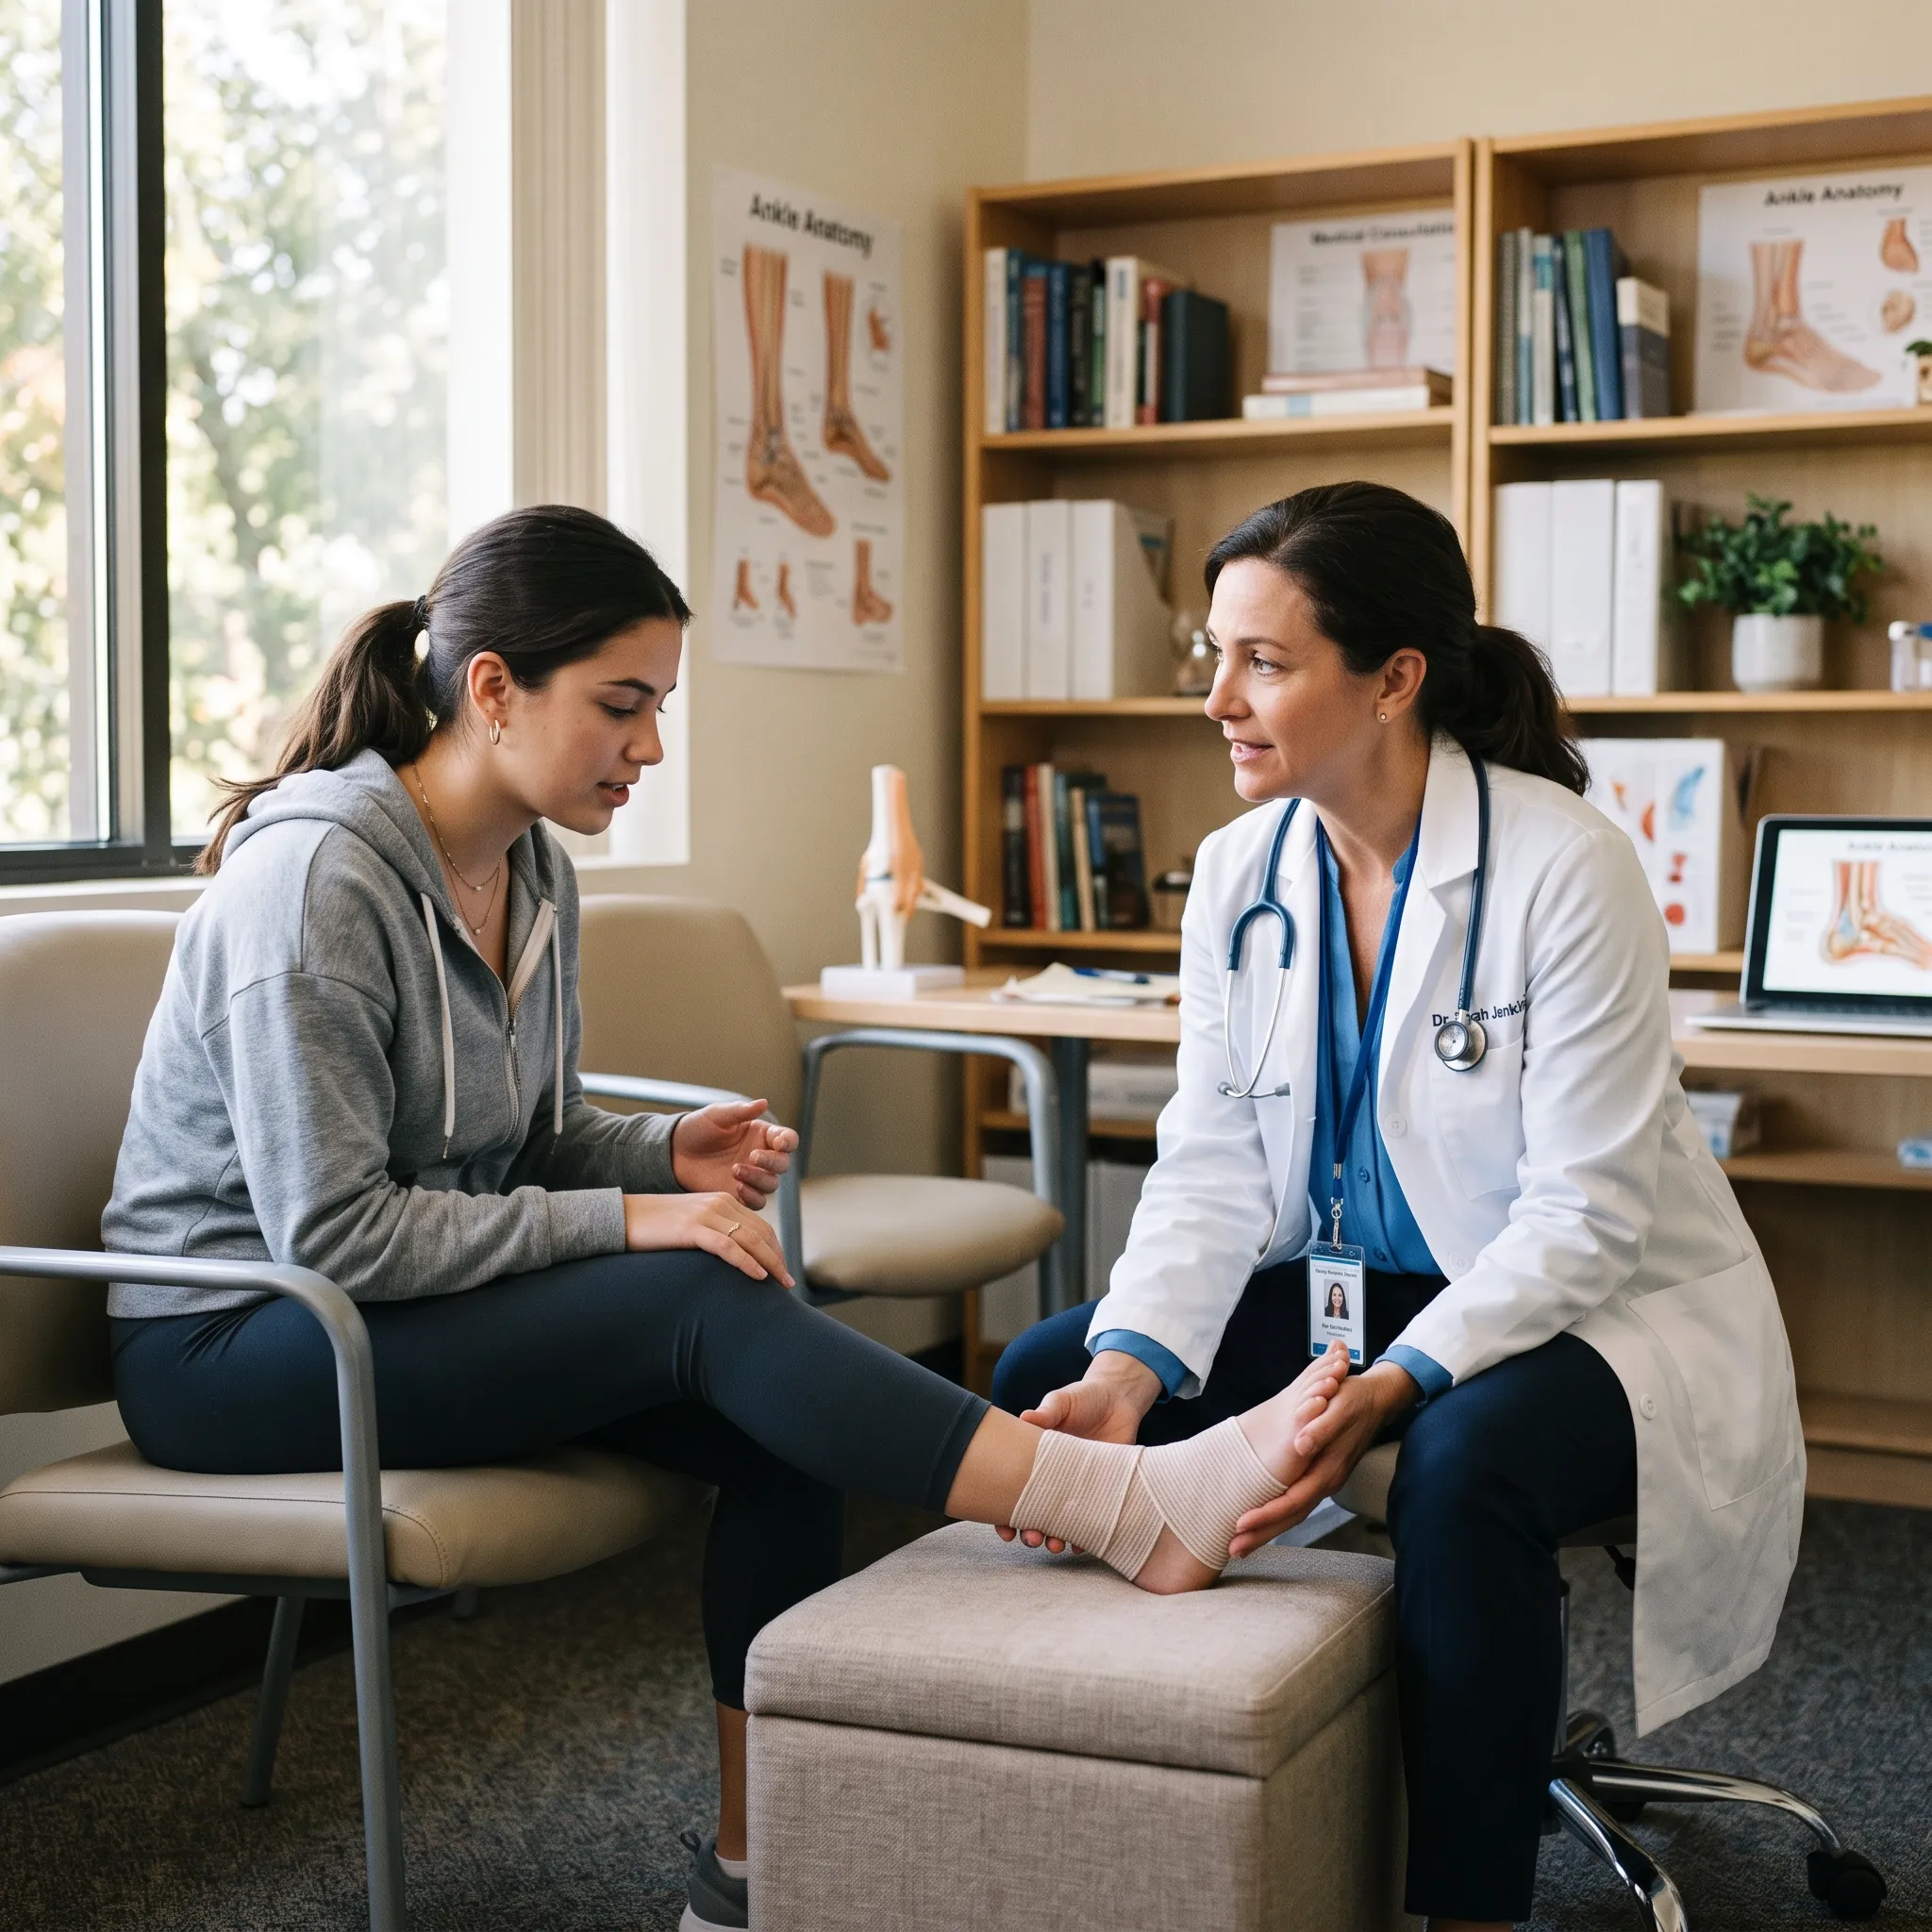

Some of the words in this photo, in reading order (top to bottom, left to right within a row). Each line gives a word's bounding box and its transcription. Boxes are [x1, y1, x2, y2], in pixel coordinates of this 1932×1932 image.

[1763, 189, 1815, 207] Ankle
[1822, 182, 1904, 201] Anatomy
[750, 193, 799, 230] Ankle
[805, 208, 874, 260] Anatomy
